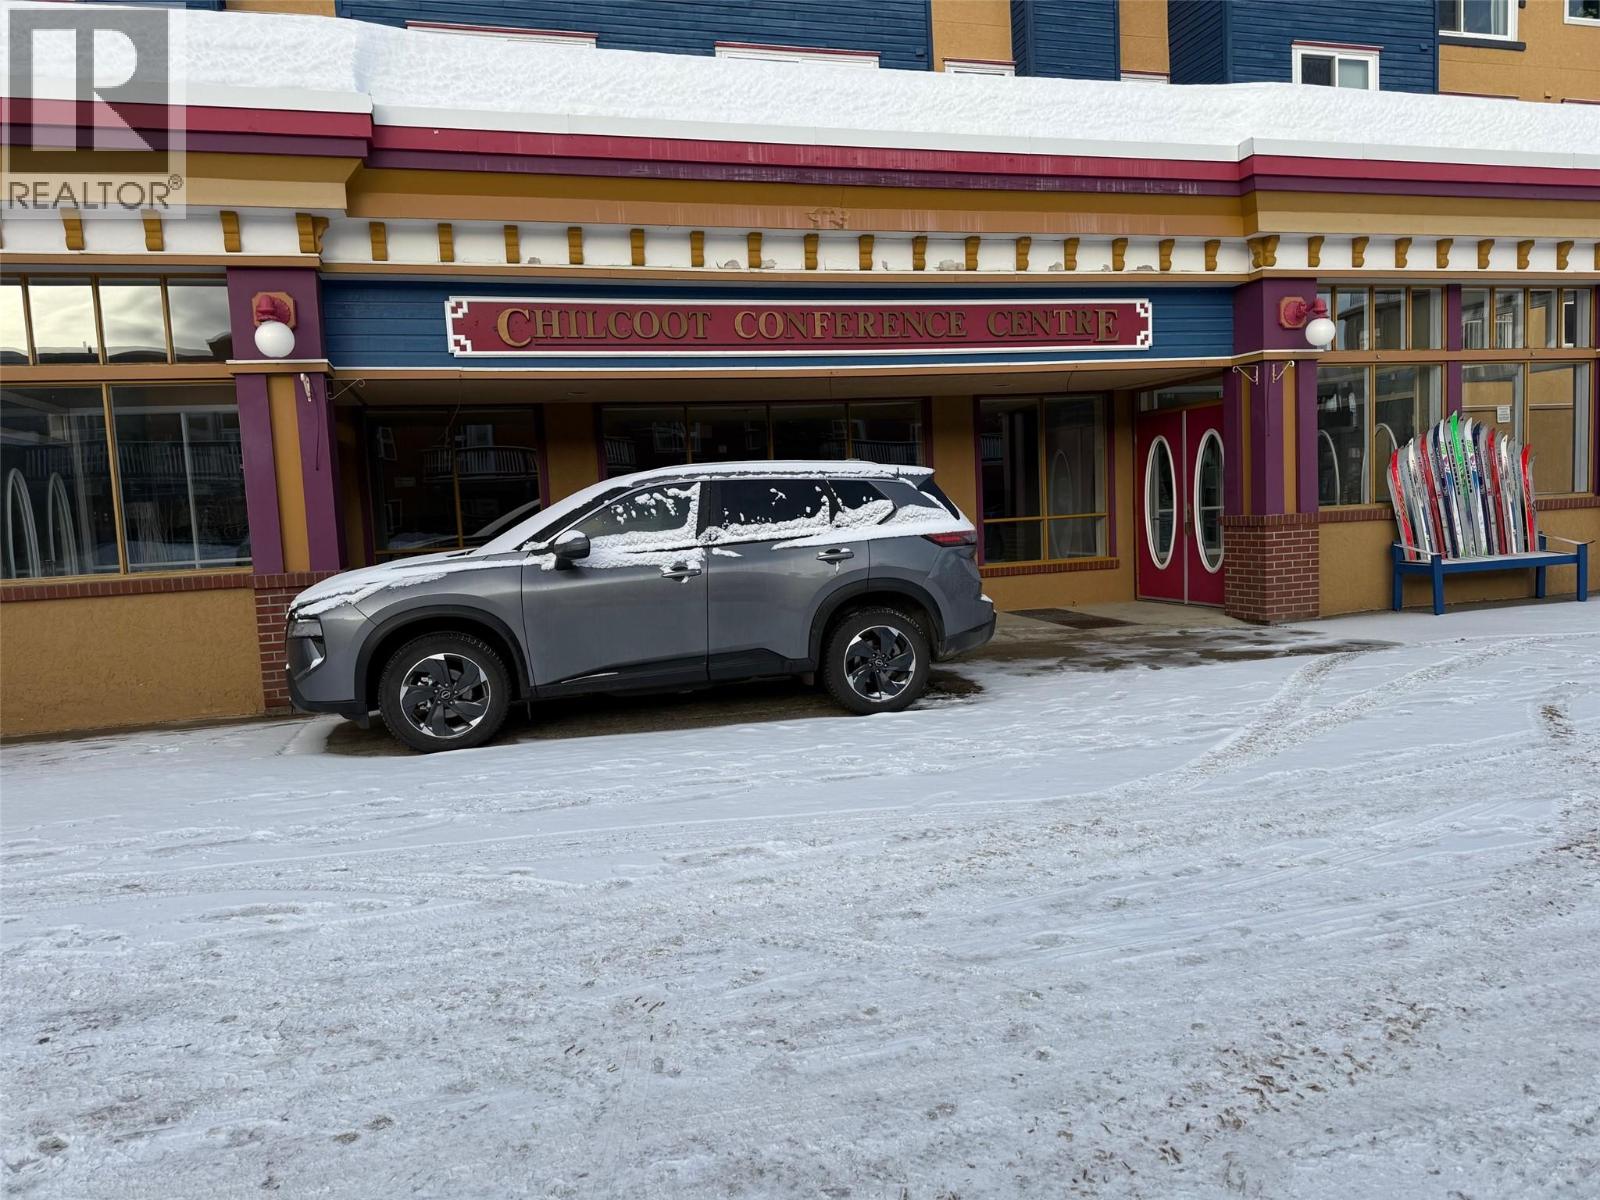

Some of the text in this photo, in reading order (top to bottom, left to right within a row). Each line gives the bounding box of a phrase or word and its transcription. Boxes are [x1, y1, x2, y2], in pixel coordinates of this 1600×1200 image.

[497, 307, 1120, 348] CHILCOOT CONFERENCE CENTRE
